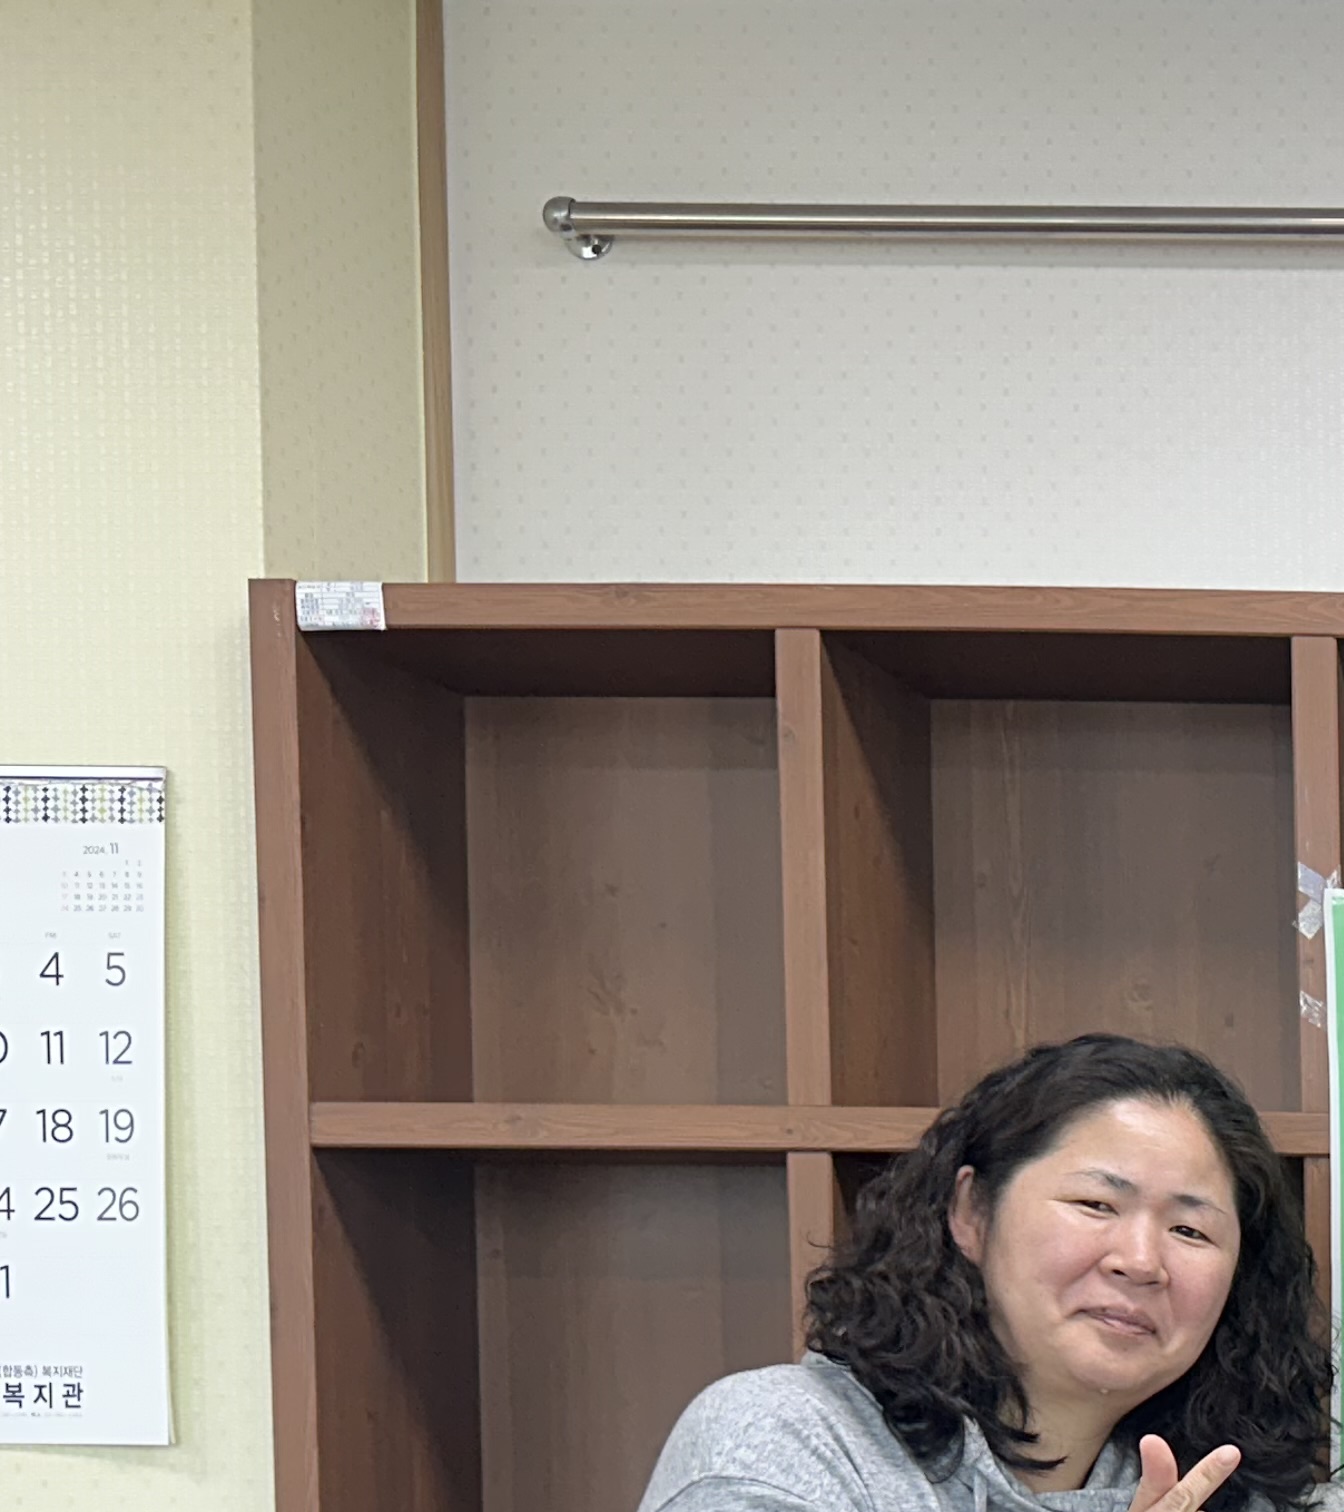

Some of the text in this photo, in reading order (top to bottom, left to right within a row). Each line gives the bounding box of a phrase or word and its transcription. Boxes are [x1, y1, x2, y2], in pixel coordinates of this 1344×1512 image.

[109, 841, 120, 855] 11
[39, 951, 126, 986] 4 5
[40, 1030, 64, 1065] 11
[99, 1030, 133, 1065] 12
[36, 1108, 74, 1143] 18
[99, 1108, 135, 1143] 19
[0, 1186, 139, 1222] 4 25 26
[2, 1382, 84, 1409] 복지관
